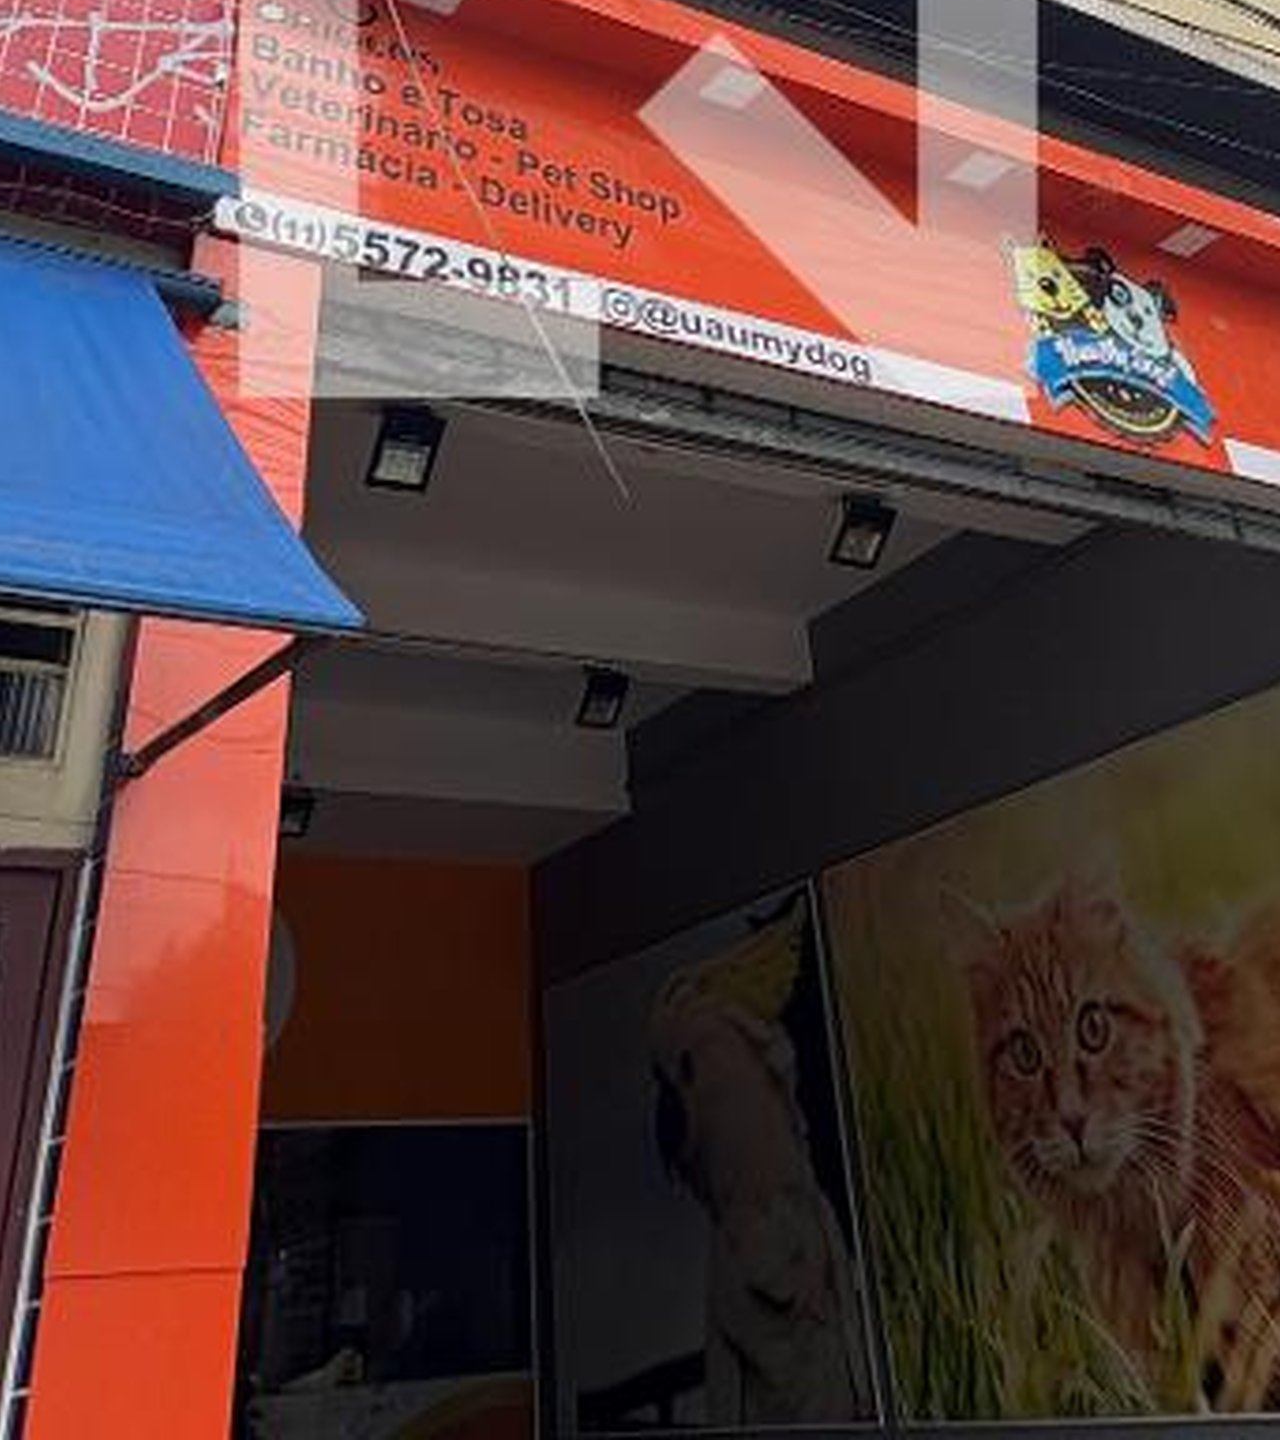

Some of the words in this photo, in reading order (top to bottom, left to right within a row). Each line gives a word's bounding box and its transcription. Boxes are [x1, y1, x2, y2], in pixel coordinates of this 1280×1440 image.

[252, 32, 387, 96] Banho
[402, 83, 424, 108] e
[438, 87, 528, 141] Tosa
[479, 174, 634, 250] Delivery
[516, 148, 578, 190] Pet
[588, 169, 682, 225] Shop
[640, 296, 871, 383] @uaumydog
